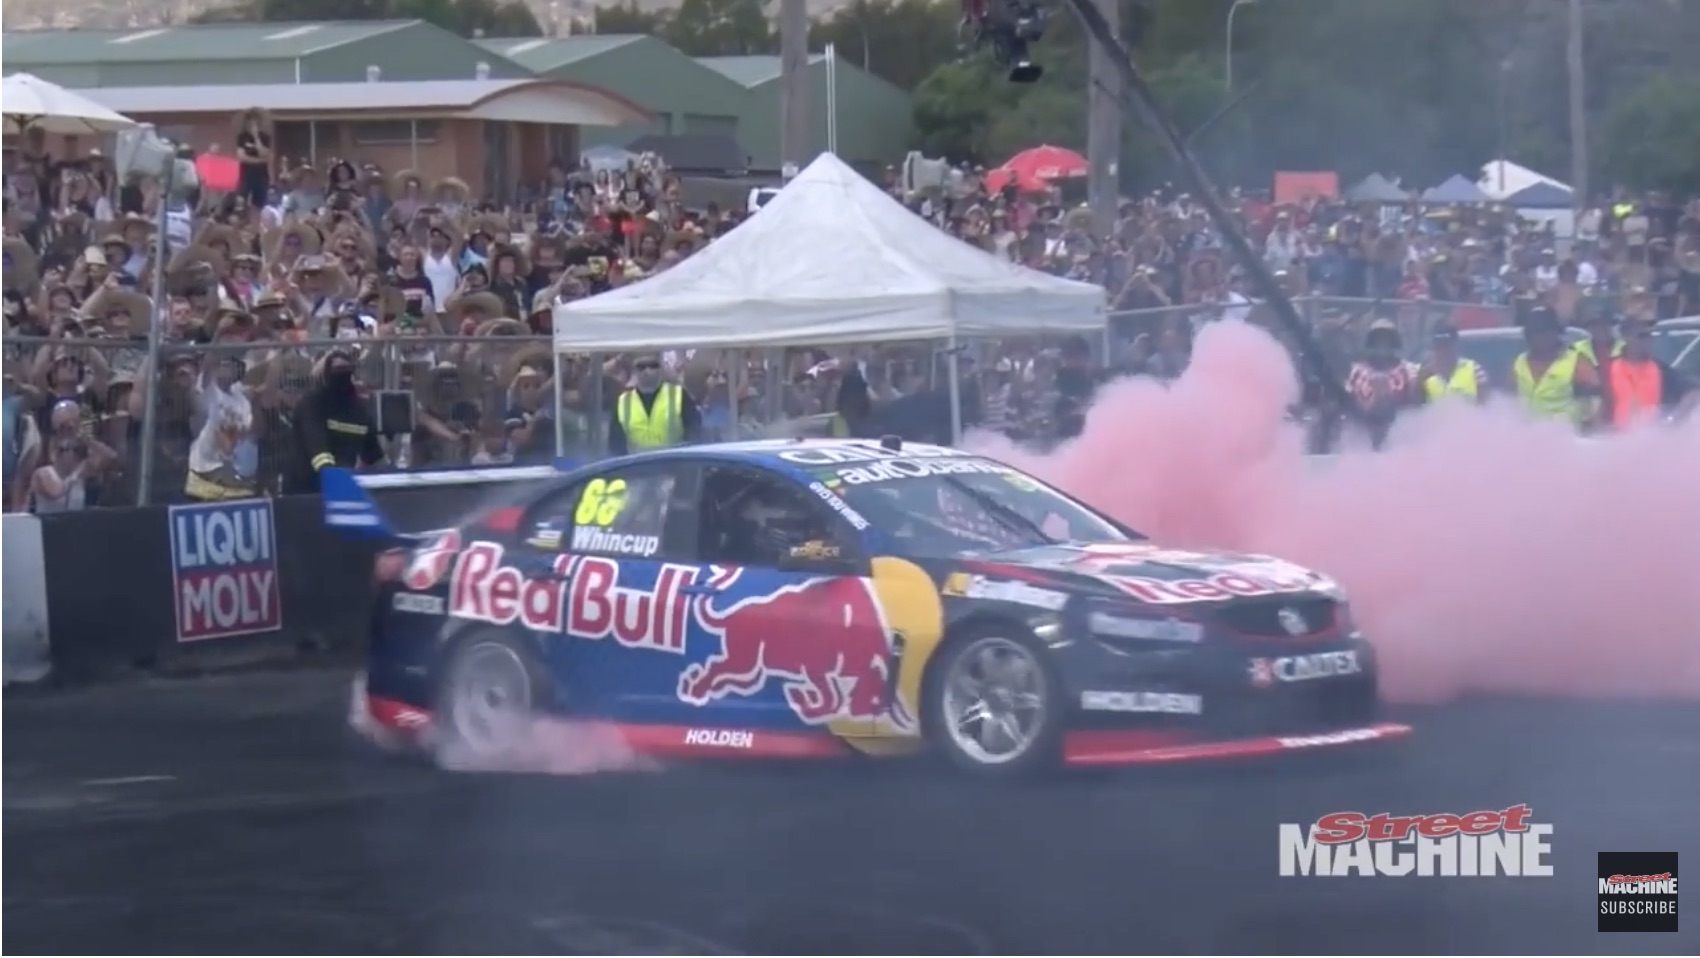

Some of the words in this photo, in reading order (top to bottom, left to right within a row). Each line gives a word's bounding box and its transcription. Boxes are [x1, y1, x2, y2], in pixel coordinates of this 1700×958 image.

[177, 508, 269, 566] LIQUI
[572, 525, 659, 557] Whincup
[182, 570, 273, 631] MOLY
[448, 540, 575, 632] Red
[567, 555, 701, 655] Bull
[685, 728, 754, 748] HOLDEN
